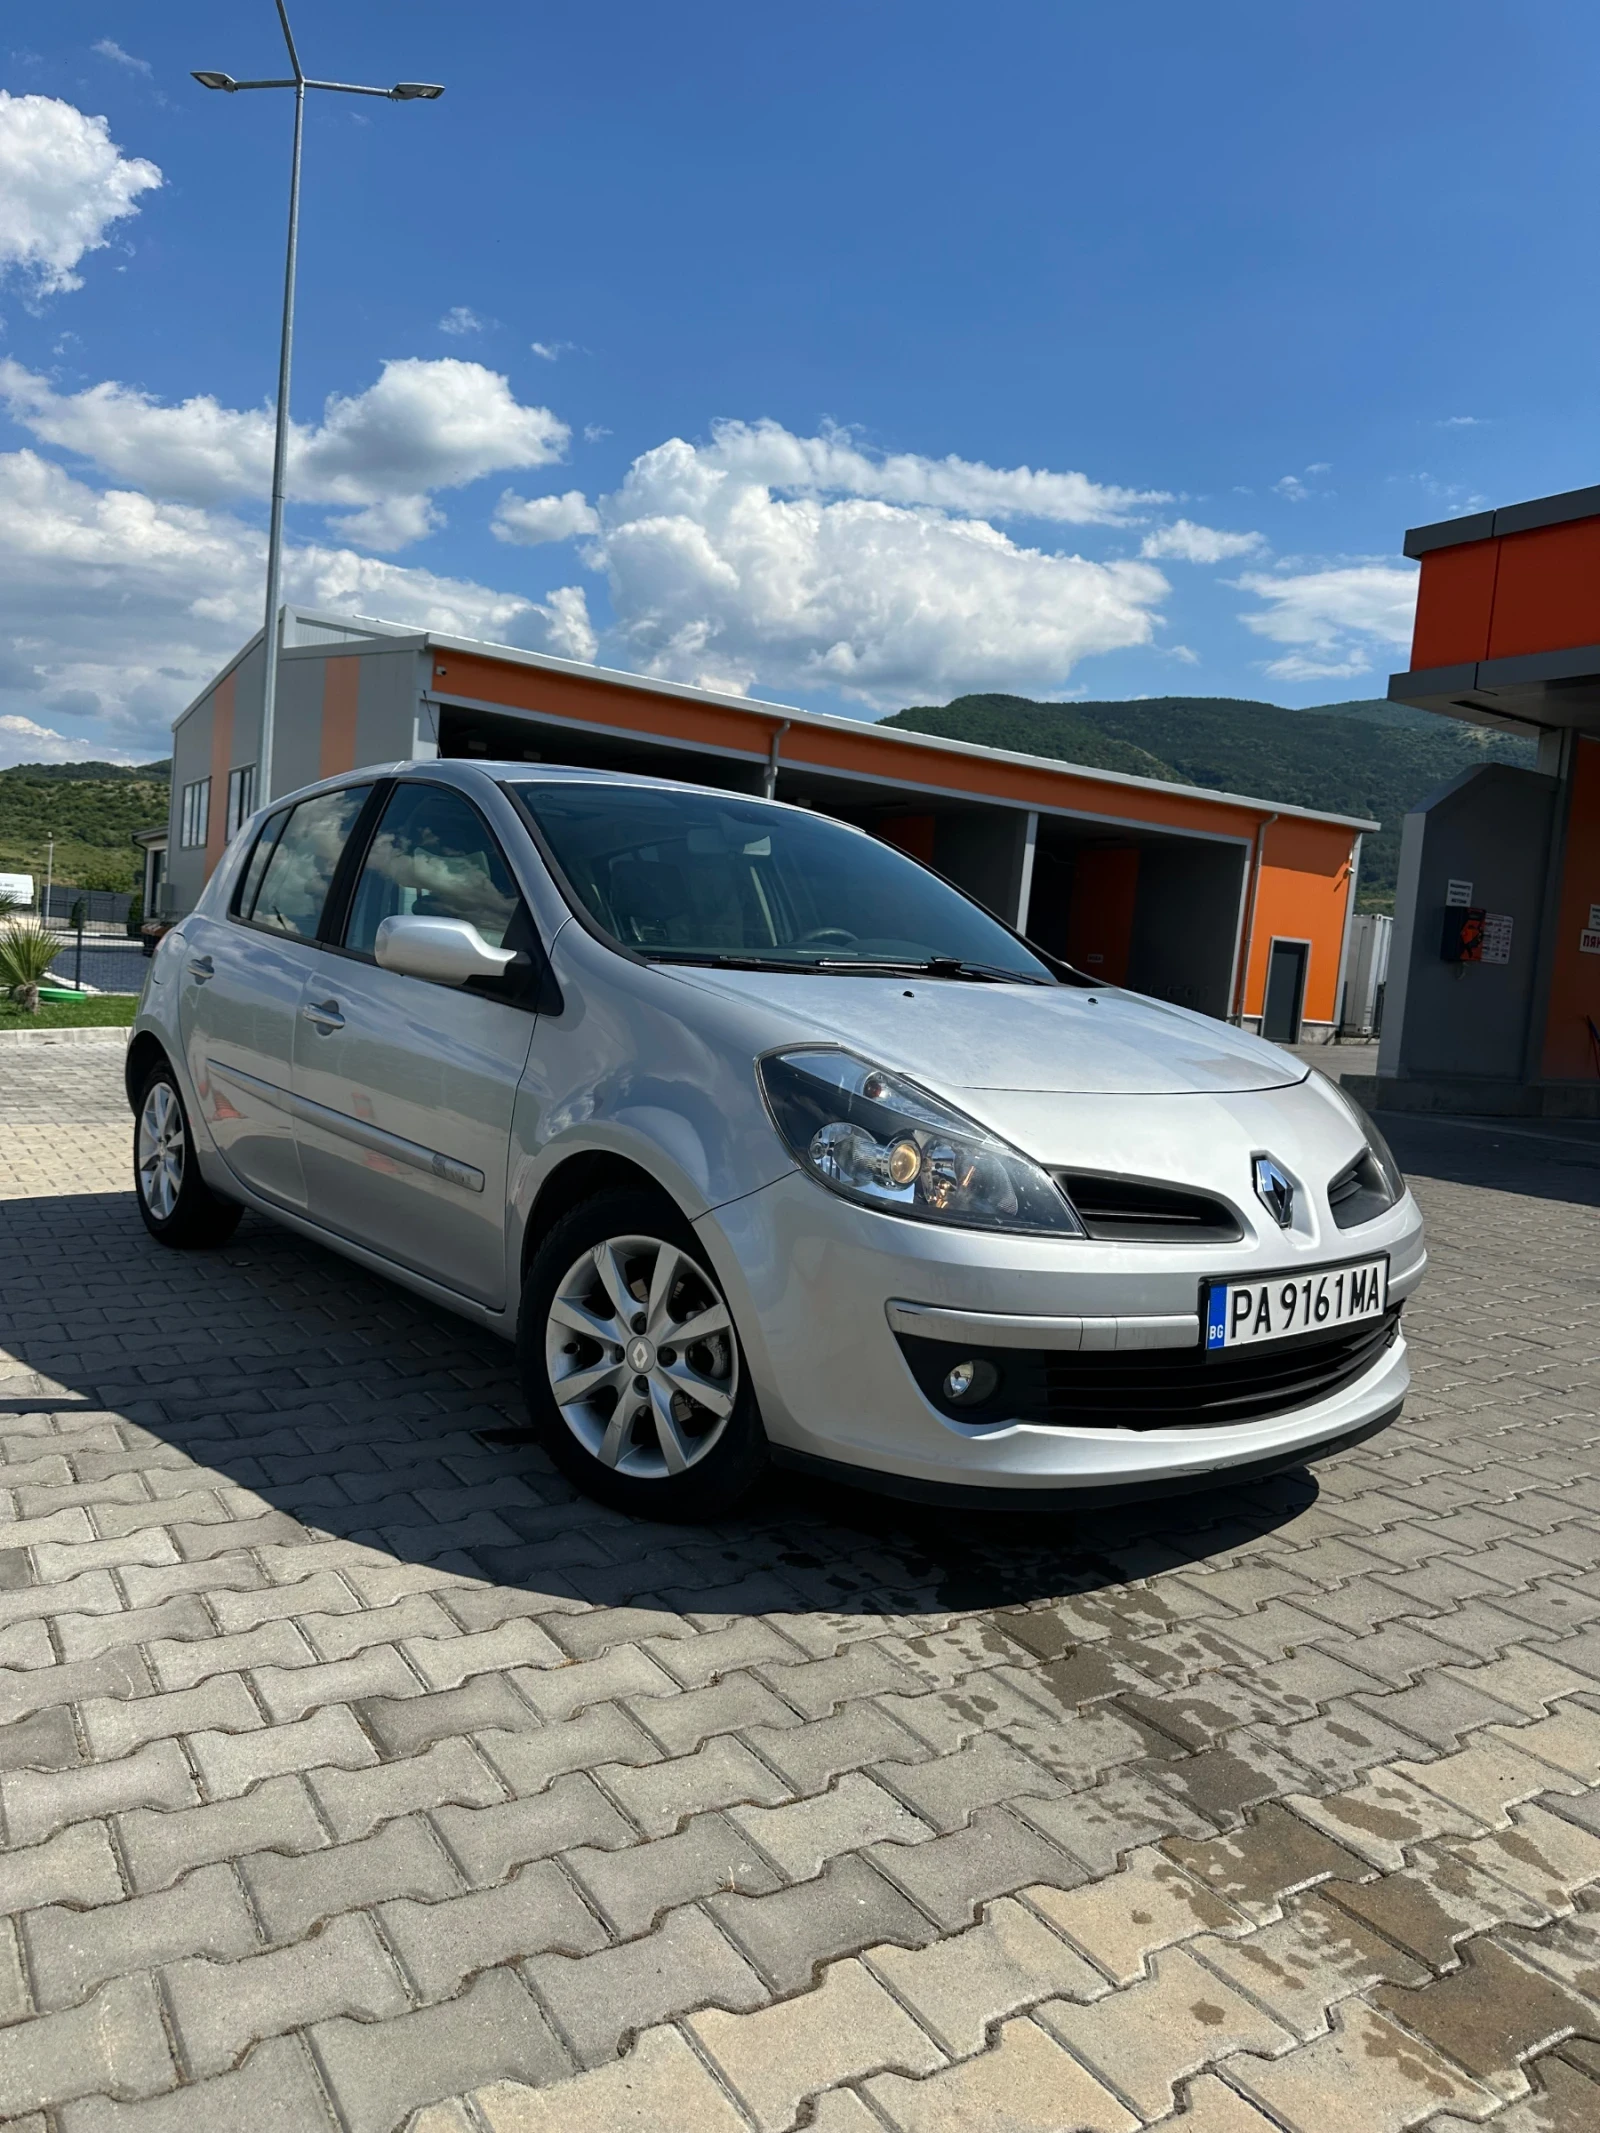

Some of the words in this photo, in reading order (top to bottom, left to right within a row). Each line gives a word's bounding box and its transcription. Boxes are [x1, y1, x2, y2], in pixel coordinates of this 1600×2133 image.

[1230, 1287, 1272, 1339] PA
[1281, 1273, 1344, 1331] 9161
[1348, 1267, 1379, 1316] MA
[1209, 1324, 1224, 1340] BG
